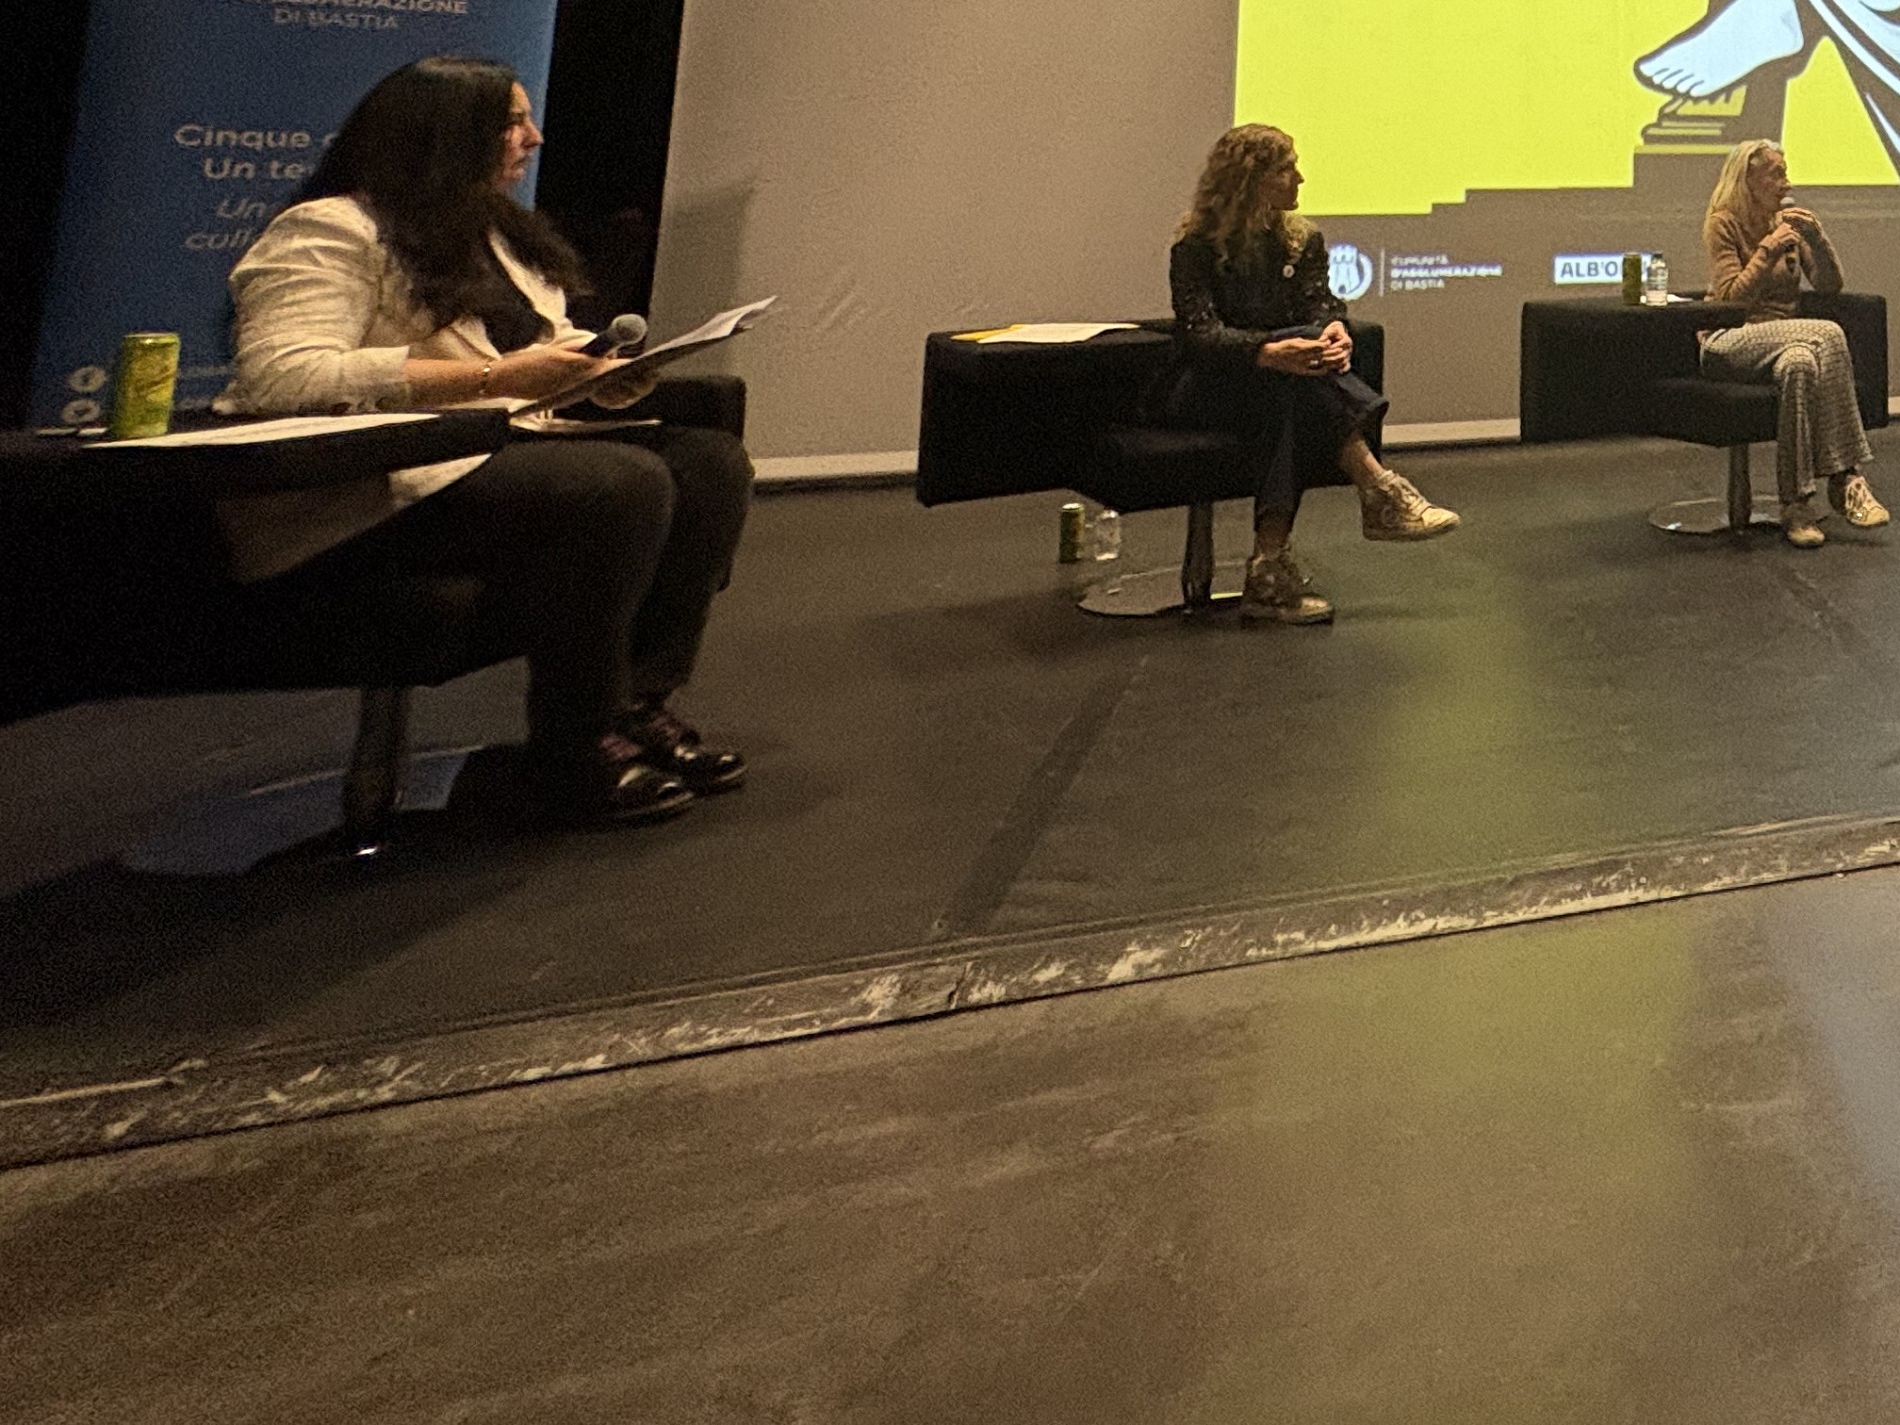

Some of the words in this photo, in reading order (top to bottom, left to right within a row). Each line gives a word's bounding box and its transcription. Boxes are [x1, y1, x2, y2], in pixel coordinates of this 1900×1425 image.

[274, 7, 300, 24] DI
[309, 11, 399, 30] BASTIA
[174, 123, 311, 151] Cinque
[204, 157, 256, 179] Un
